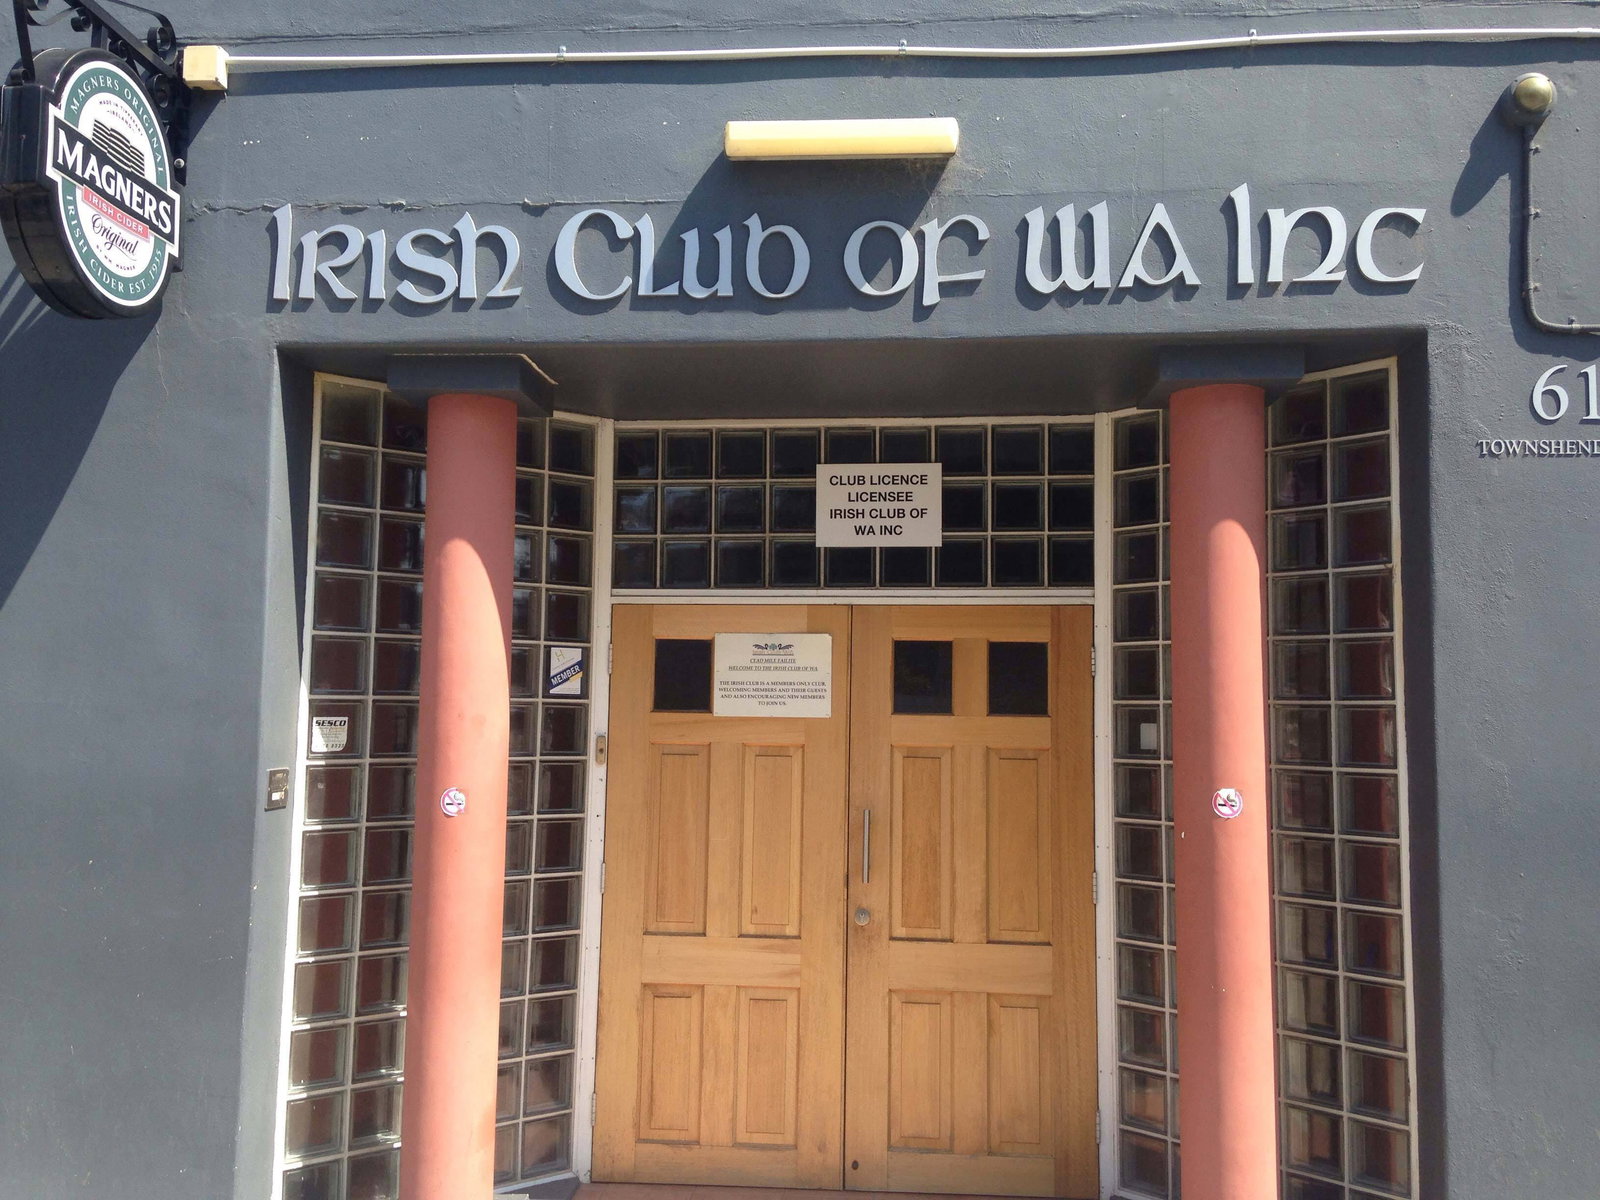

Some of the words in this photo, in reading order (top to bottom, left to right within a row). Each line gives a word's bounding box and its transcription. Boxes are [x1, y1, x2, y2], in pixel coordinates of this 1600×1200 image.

[69, 75, 120, 114] MAGNERS
[124, 88, 165, 172] ORIGINAL
[57, 127, 172, 234] MAGNERS
[88, 193, 115, 217] IRISH
[117, 213, 144, 234] CIDER
[66, 195, 88, 253] IRISH
[90, 258, 125, 293] CIDER
[129, 278, 151, 294] EST.
[148, 248, 162, 280] 1935
[91, 213, 139, 259] Original
[1024, 200, 1202, 294] WA
[1532, 364, 1600, 420] 61
[829, 475, 866, 486] CLUB
[870, 474, 928, 486] LICENCE
[847, 491, 914, 502] LICENSEE
[829, 508, 865, 519] IRISH
[869, 508, 906, 519] CLUB
[909, 508, 928, 519] OF
[854, 525, 876, 536] WA
[879, 525, 903, 536] INC
[551, 664, 581, 686] MEMBER
[315, 719, 347, 727] SESCO
